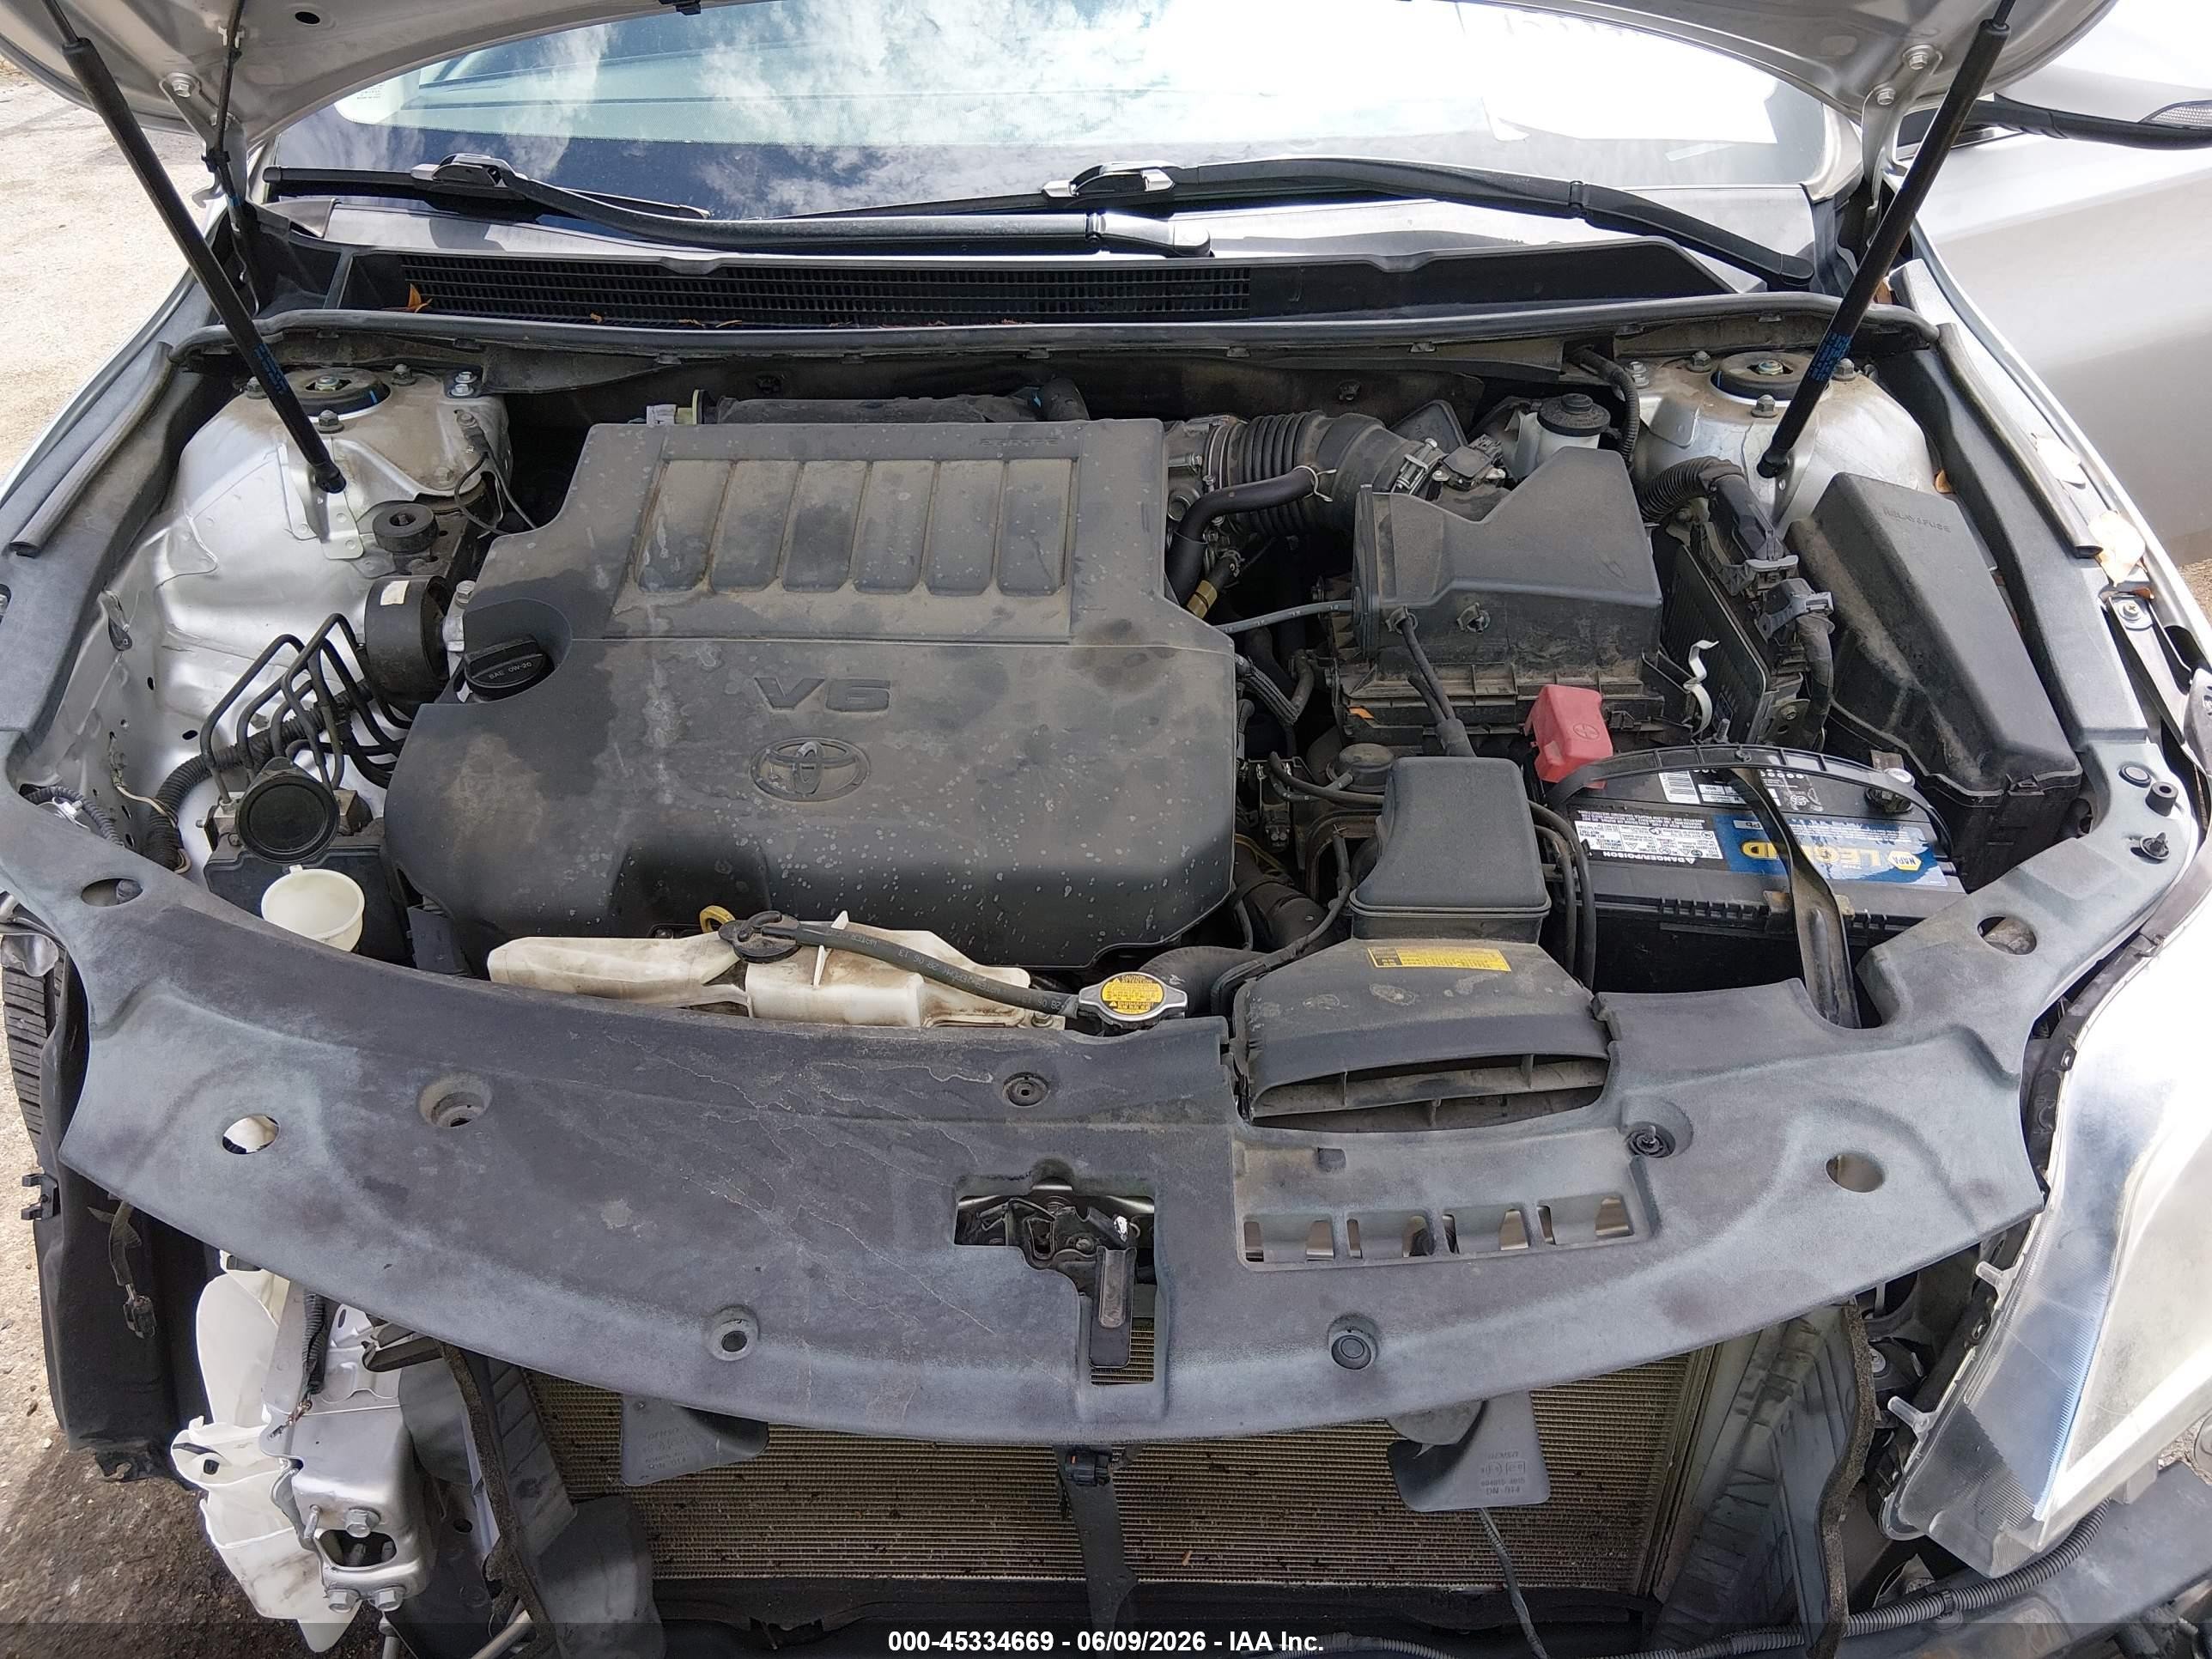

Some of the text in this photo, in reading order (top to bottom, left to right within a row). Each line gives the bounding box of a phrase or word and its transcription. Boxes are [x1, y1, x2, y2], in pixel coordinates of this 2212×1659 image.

[489, 661, 532, 679] SAE 0W-20
[754, 678, 891, 712] V6
[1893, 855, 1916, 866] NAPA
